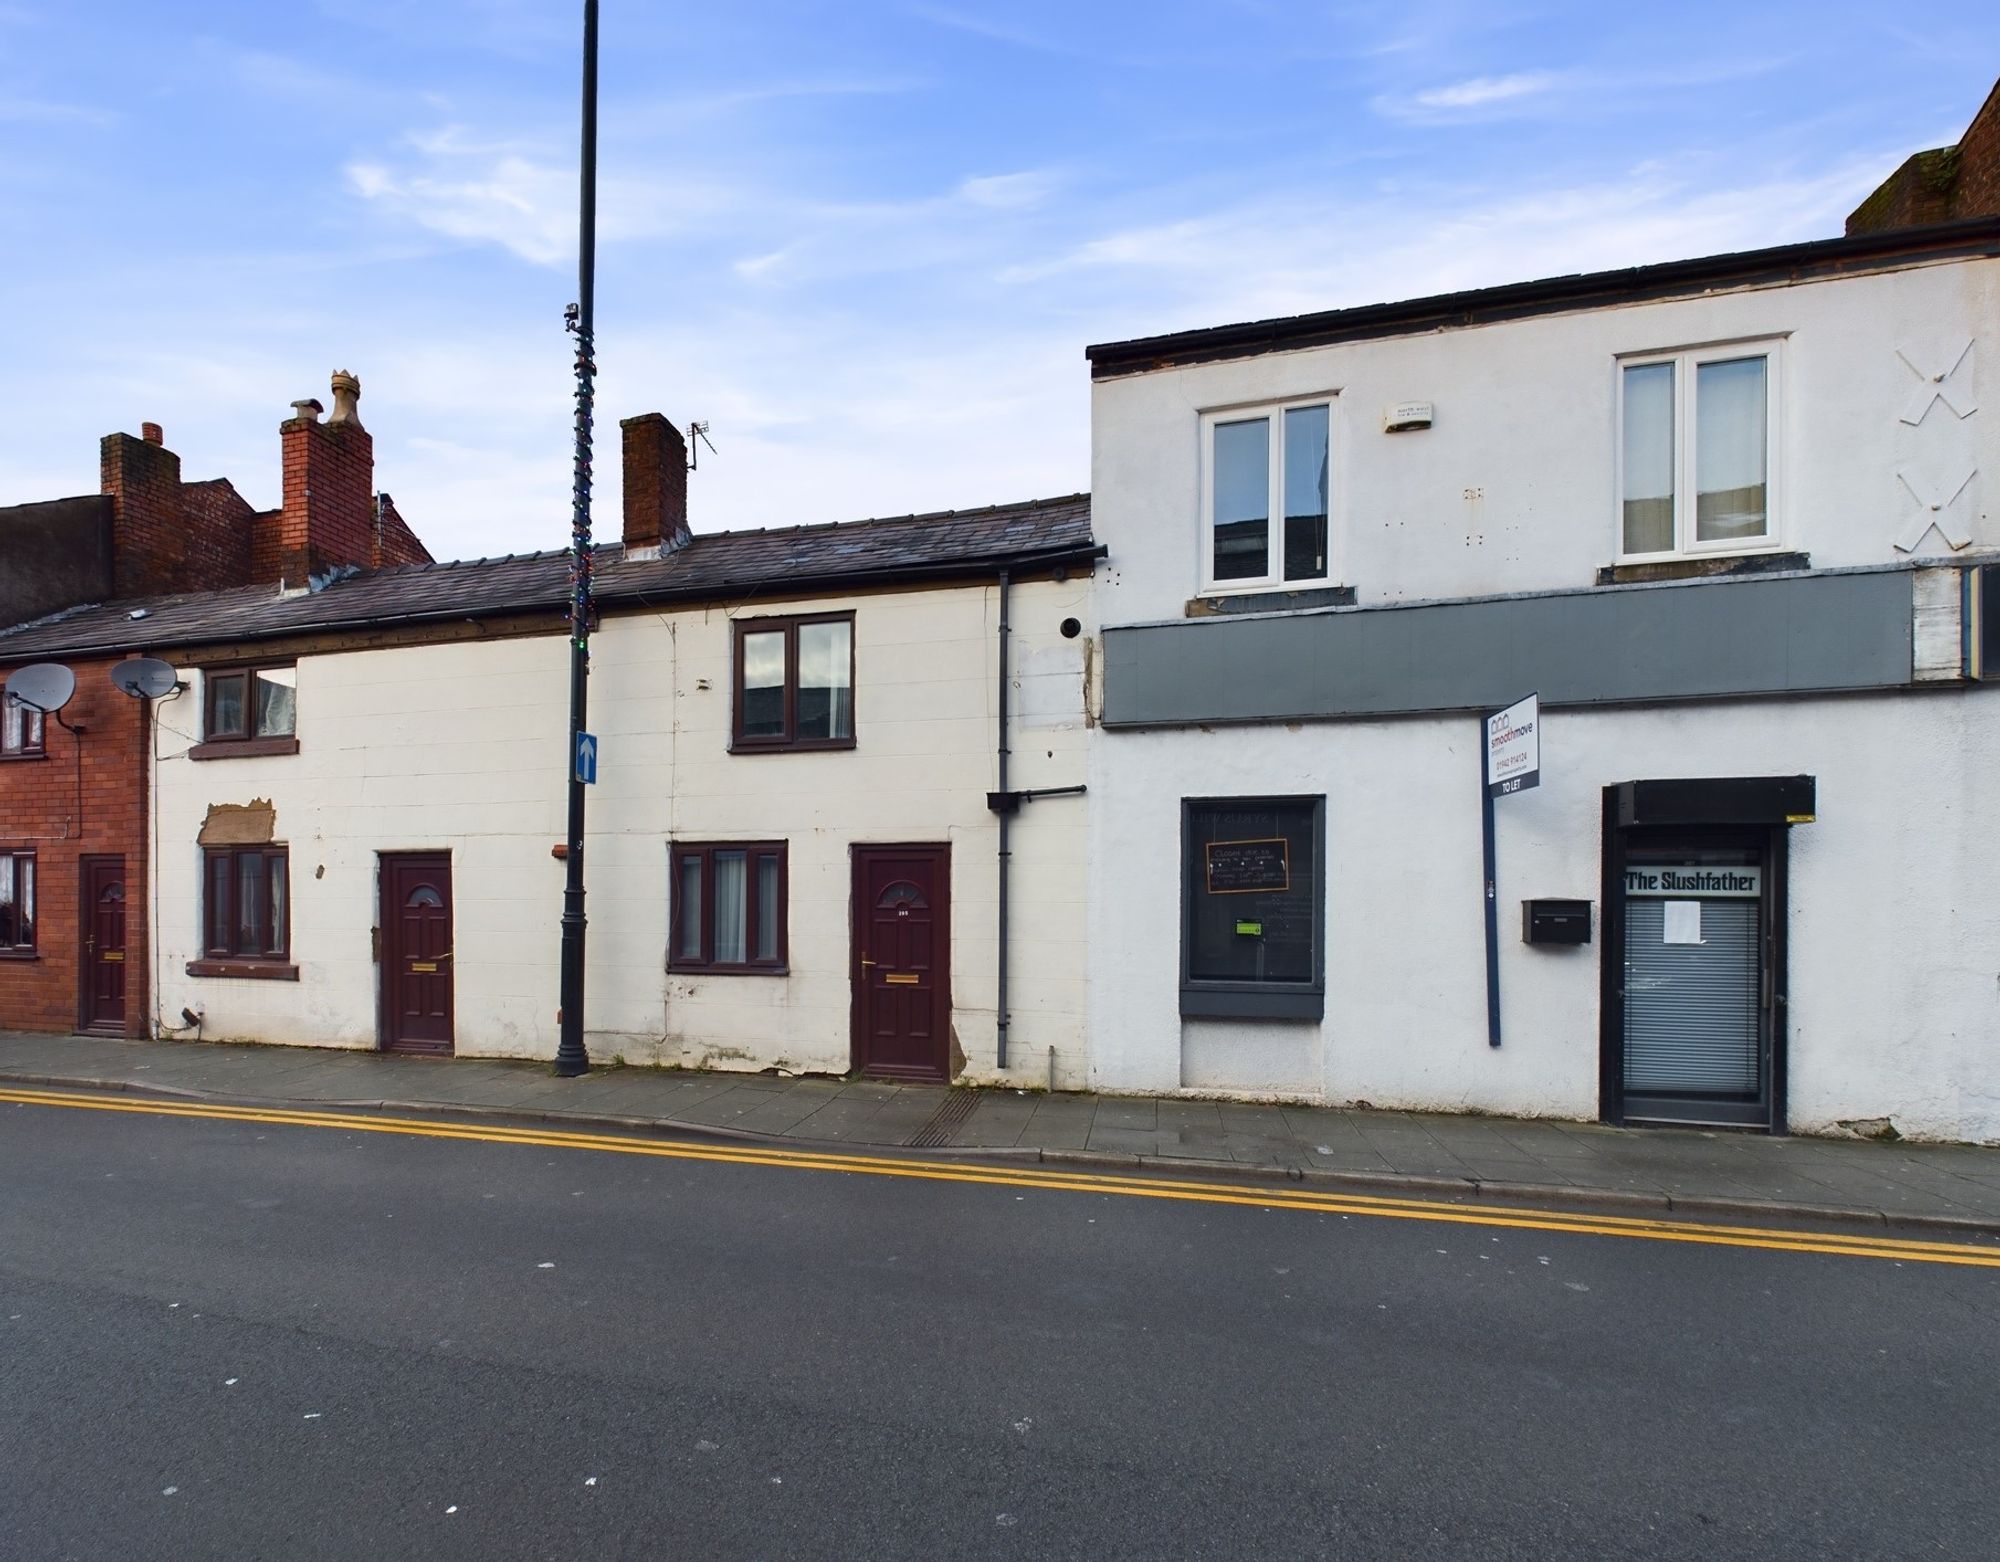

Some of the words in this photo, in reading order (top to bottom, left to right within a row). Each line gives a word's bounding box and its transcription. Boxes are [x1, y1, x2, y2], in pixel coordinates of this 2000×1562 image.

[1491, 722, 1533, 748] smoothmove
[1502, 782, 1511, 794] TO
[1511, 779, 1521, 791] LET
[1624, 871, 1658, 890] The
[1661, 871, 1756, 891] Slushfather
